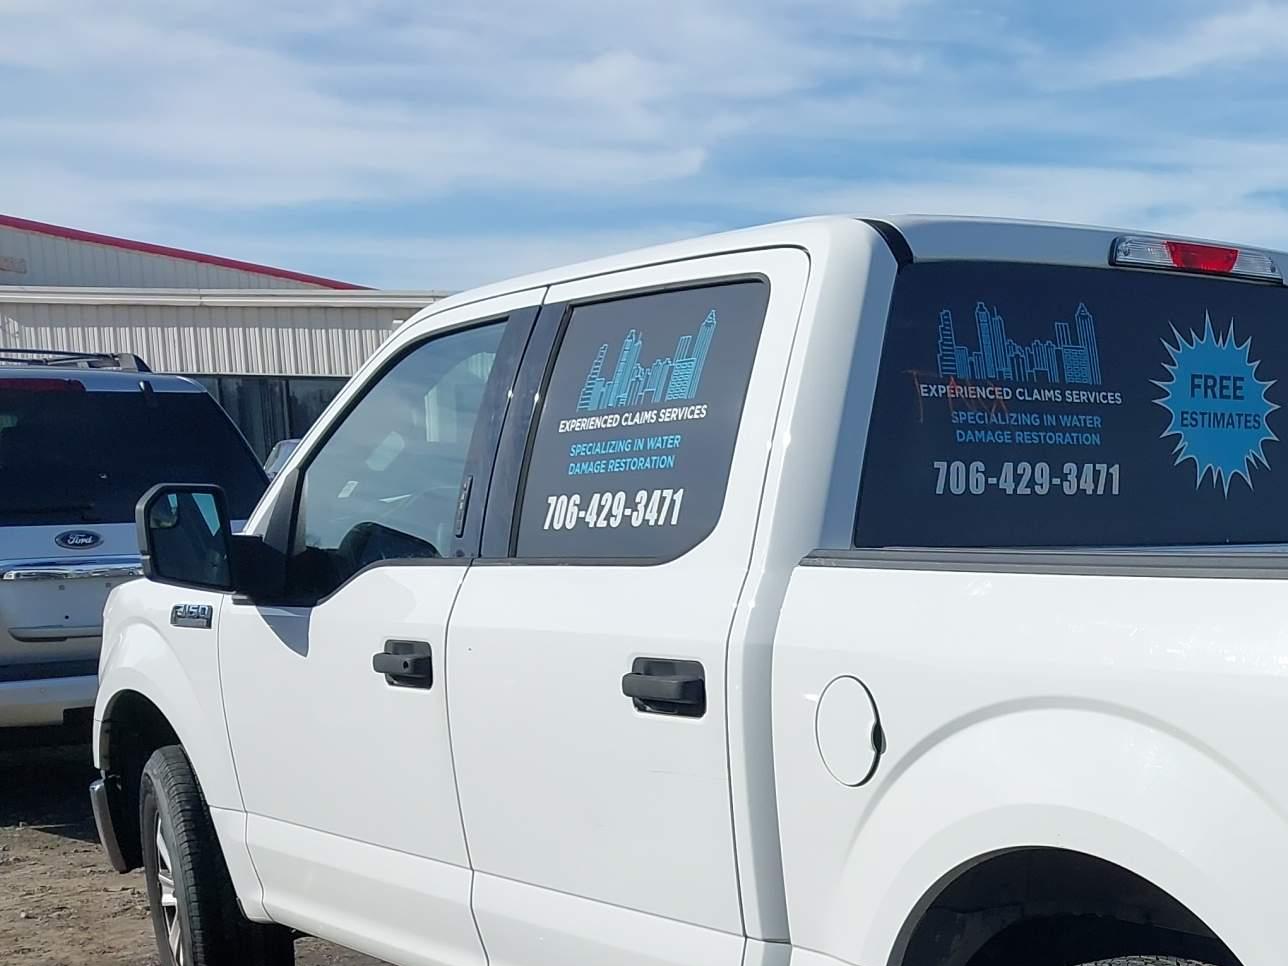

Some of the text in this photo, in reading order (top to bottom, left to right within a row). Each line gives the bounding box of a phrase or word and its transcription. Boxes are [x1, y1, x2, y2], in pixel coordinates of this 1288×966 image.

[920, 384, 1122, 404] EXPERIENCED CLAIMS SERVICES
[1190, 373, 1245, 401] FREE
[559, 404, 708, 432] EXPERIENCED CLAIMS SERVICES
[951, 411, 1101, 428] SPECIALIZING IN WATER
[1180, 411, 1261, 430] ESTIMATES
[570, 435, 681, 456] SPECIALIZING IN WATER
[956, 430, 1101, 446] DAMAGE RESTORATION
[568, 455, 675, 476] DAMAGE RESTORATION
[933, 460, 1121, 495] 706-429-3471
[544, 488, 685, 530] 706-429-3471
[66, 534, 94, 545] Ford
